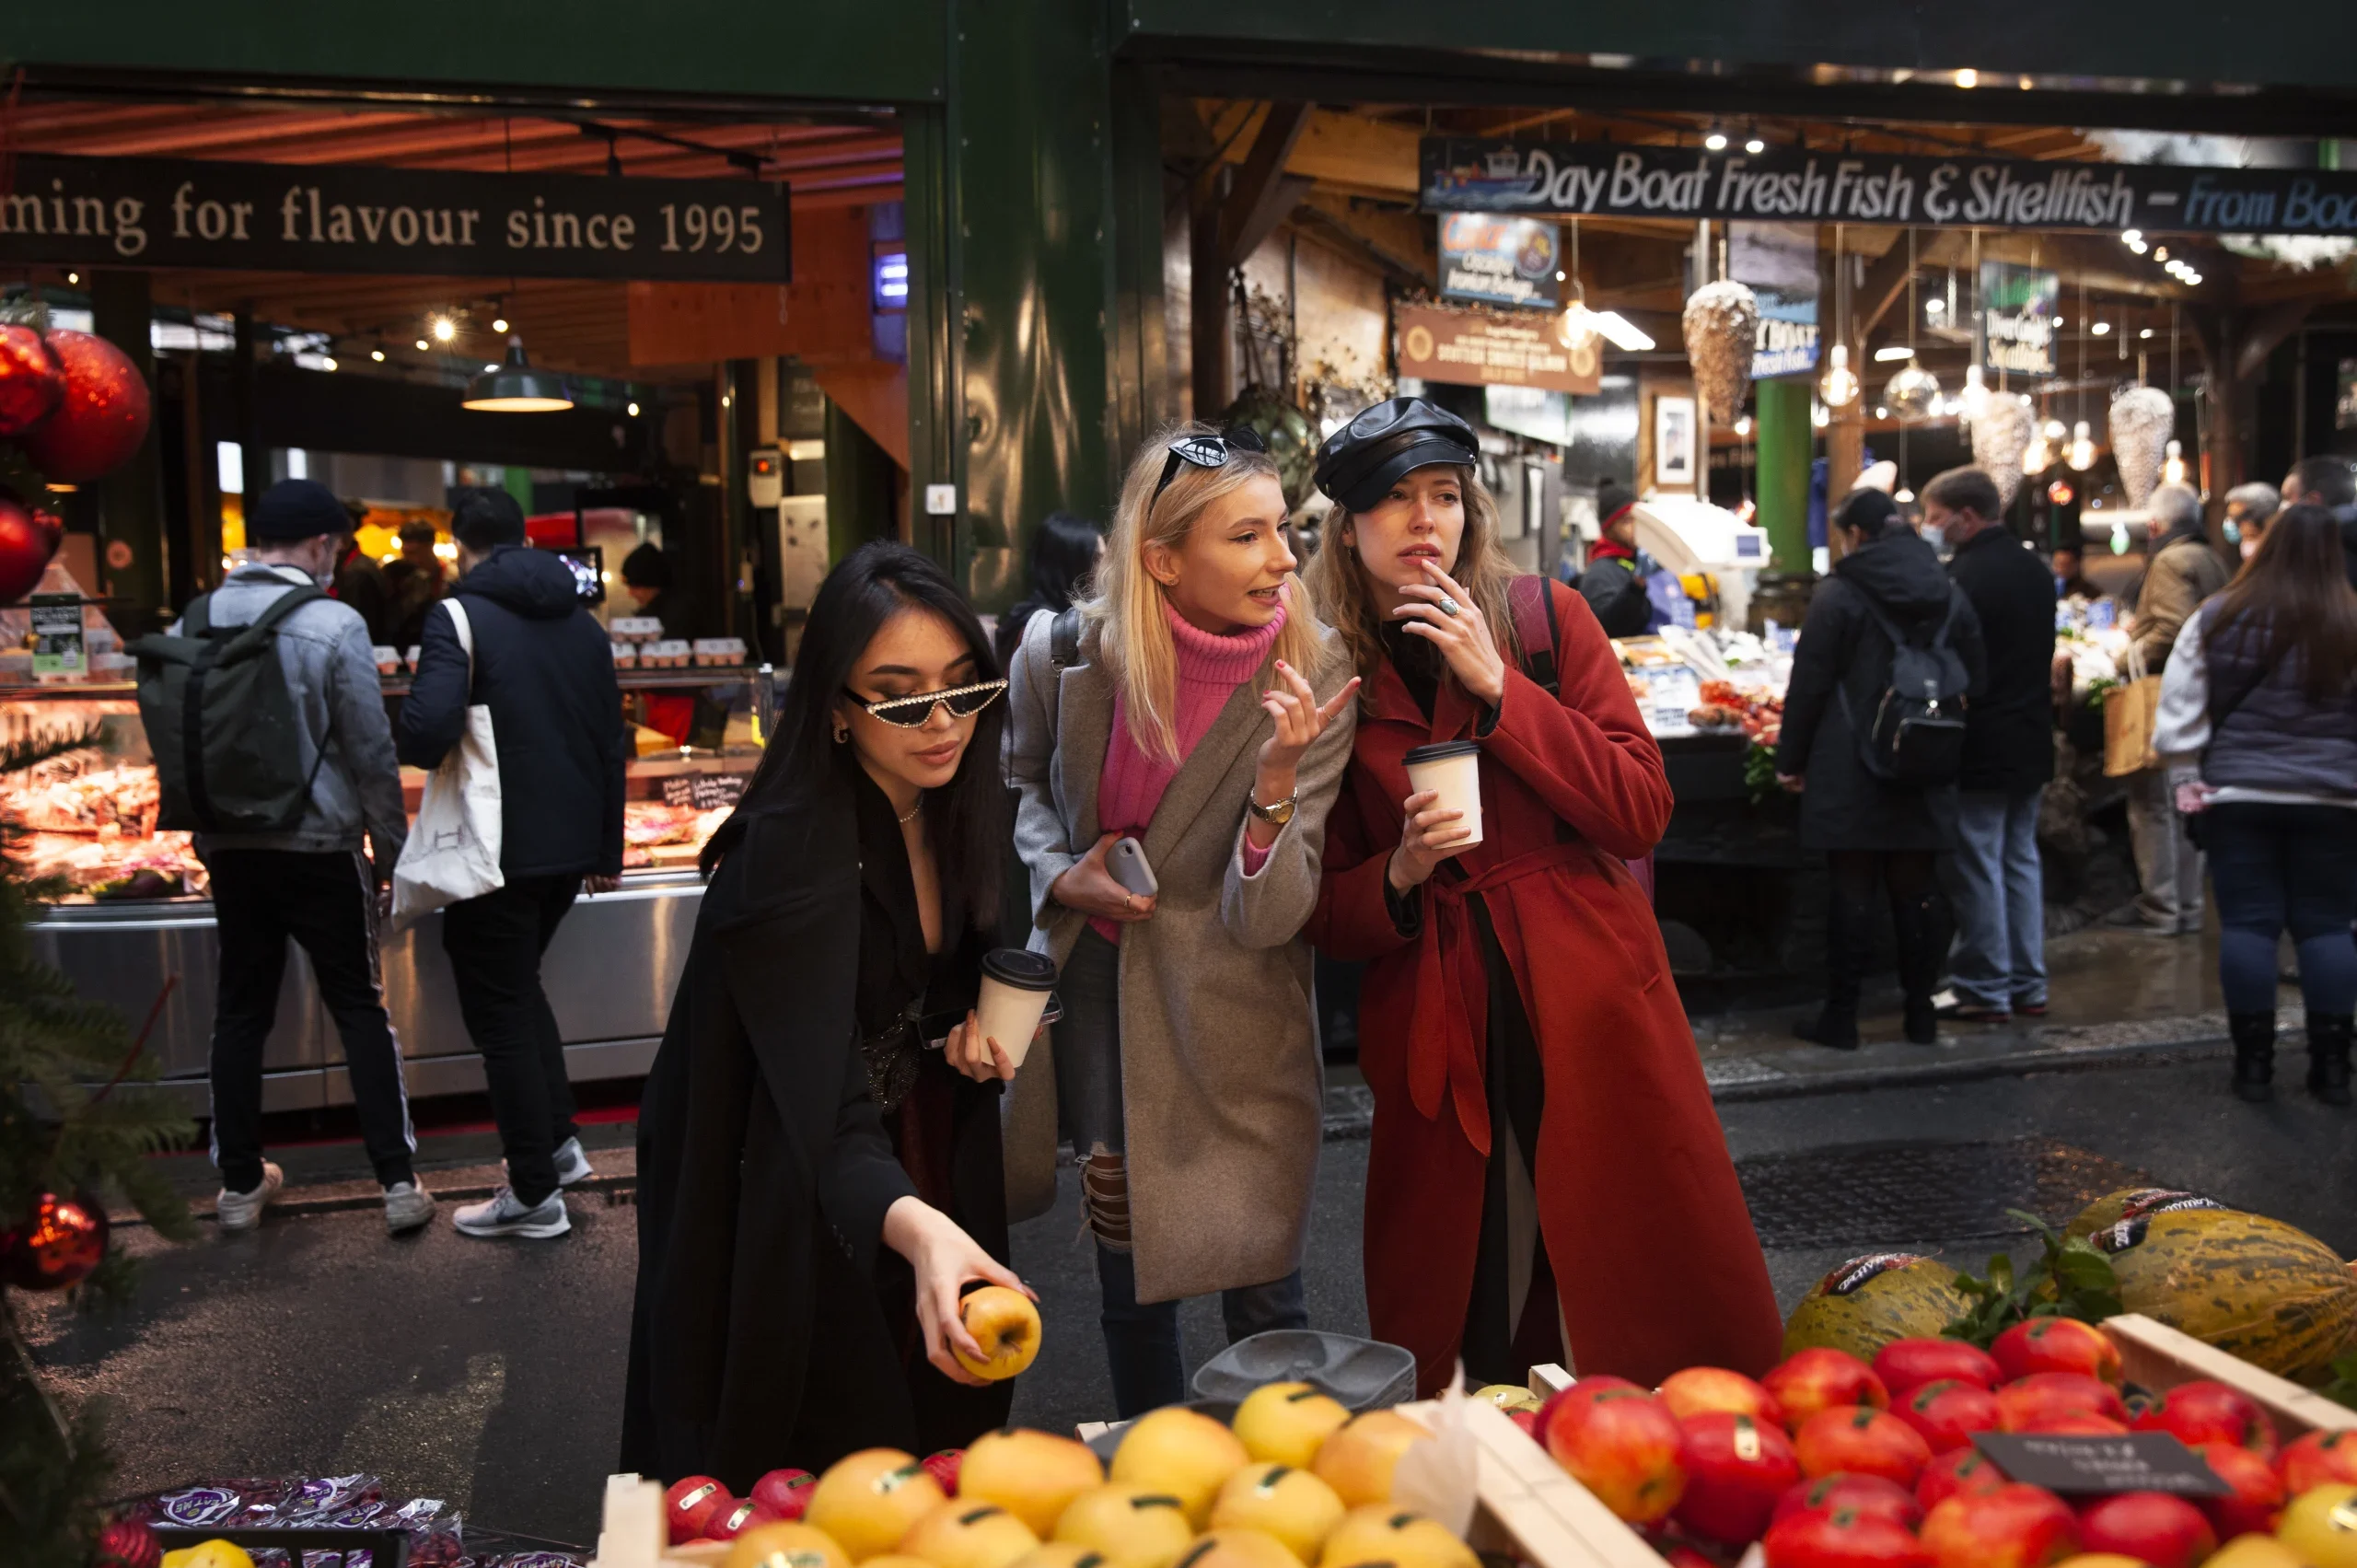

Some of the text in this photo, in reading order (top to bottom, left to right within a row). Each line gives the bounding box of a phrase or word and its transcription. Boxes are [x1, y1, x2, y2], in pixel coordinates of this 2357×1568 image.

[1521, 149, 1608, 214] Day
[1608, 151, 1712, 209] Boat
[1715, 157, 1823, 216] Fresh
[1828, 160, 1914, 221] Fish
[1922, 163, 1962, 224] &
[1962, 164, 2136, 228] Shellfish
[2183, 173, 2277, 226] From
[0, 178, 764, 257] ming for flavour since 1995
[174, 1500, 193, 1514] ME
[193, 1498, 220, 1507] EAT
